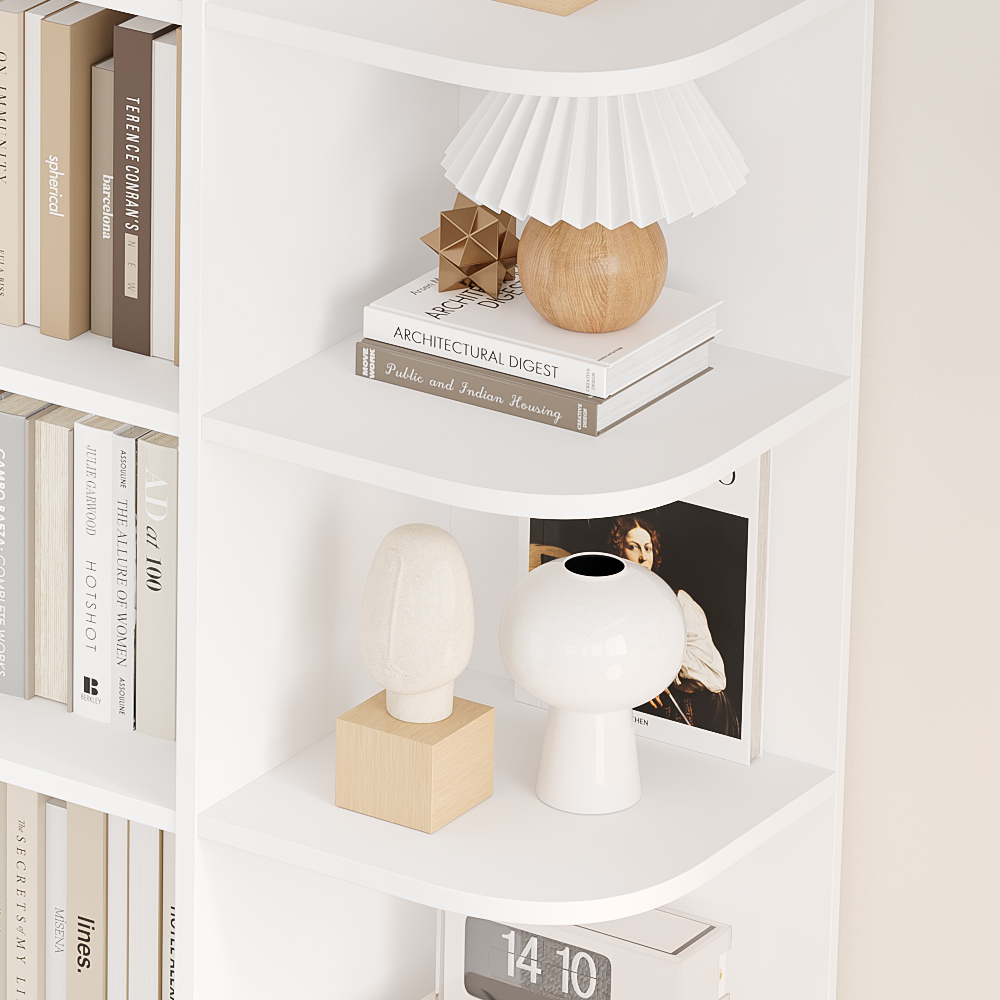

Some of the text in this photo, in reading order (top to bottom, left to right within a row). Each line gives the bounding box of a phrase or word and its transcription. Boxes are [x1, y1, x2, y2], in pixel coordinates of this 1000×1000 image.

[45, 154, 65, 218] spherical
[125, 96, 140, 231] TERENCE CONRAN'S
[102, 174, 114, 240] barcelona
[127, 240, 136, 292] NEW
[393, 326, 559, 379] ARCHITECTURAL DIGEST
[385, 362, 562, 423] Public and Indian Housing
[85, 444, 97, 536] JULIE GARWOOD
[119, 449, 127, 489] ASSOULINE
[144, 466, 168, 592] AD at 100
[85, 560, 97, 652] HOTSHOT
[116, 499, 128, 668] THE ALLURE OF WOMEN
[80, 692, 101, 705] BERKLEY
[118, 677, 126, 715] ASSOULINE
[16, 835, 26, 923] SECRETS
[16, 936, 26, 965] MY
[77, 916, 95, 973] lines.
[501, 929, 597, 999] 14 10
